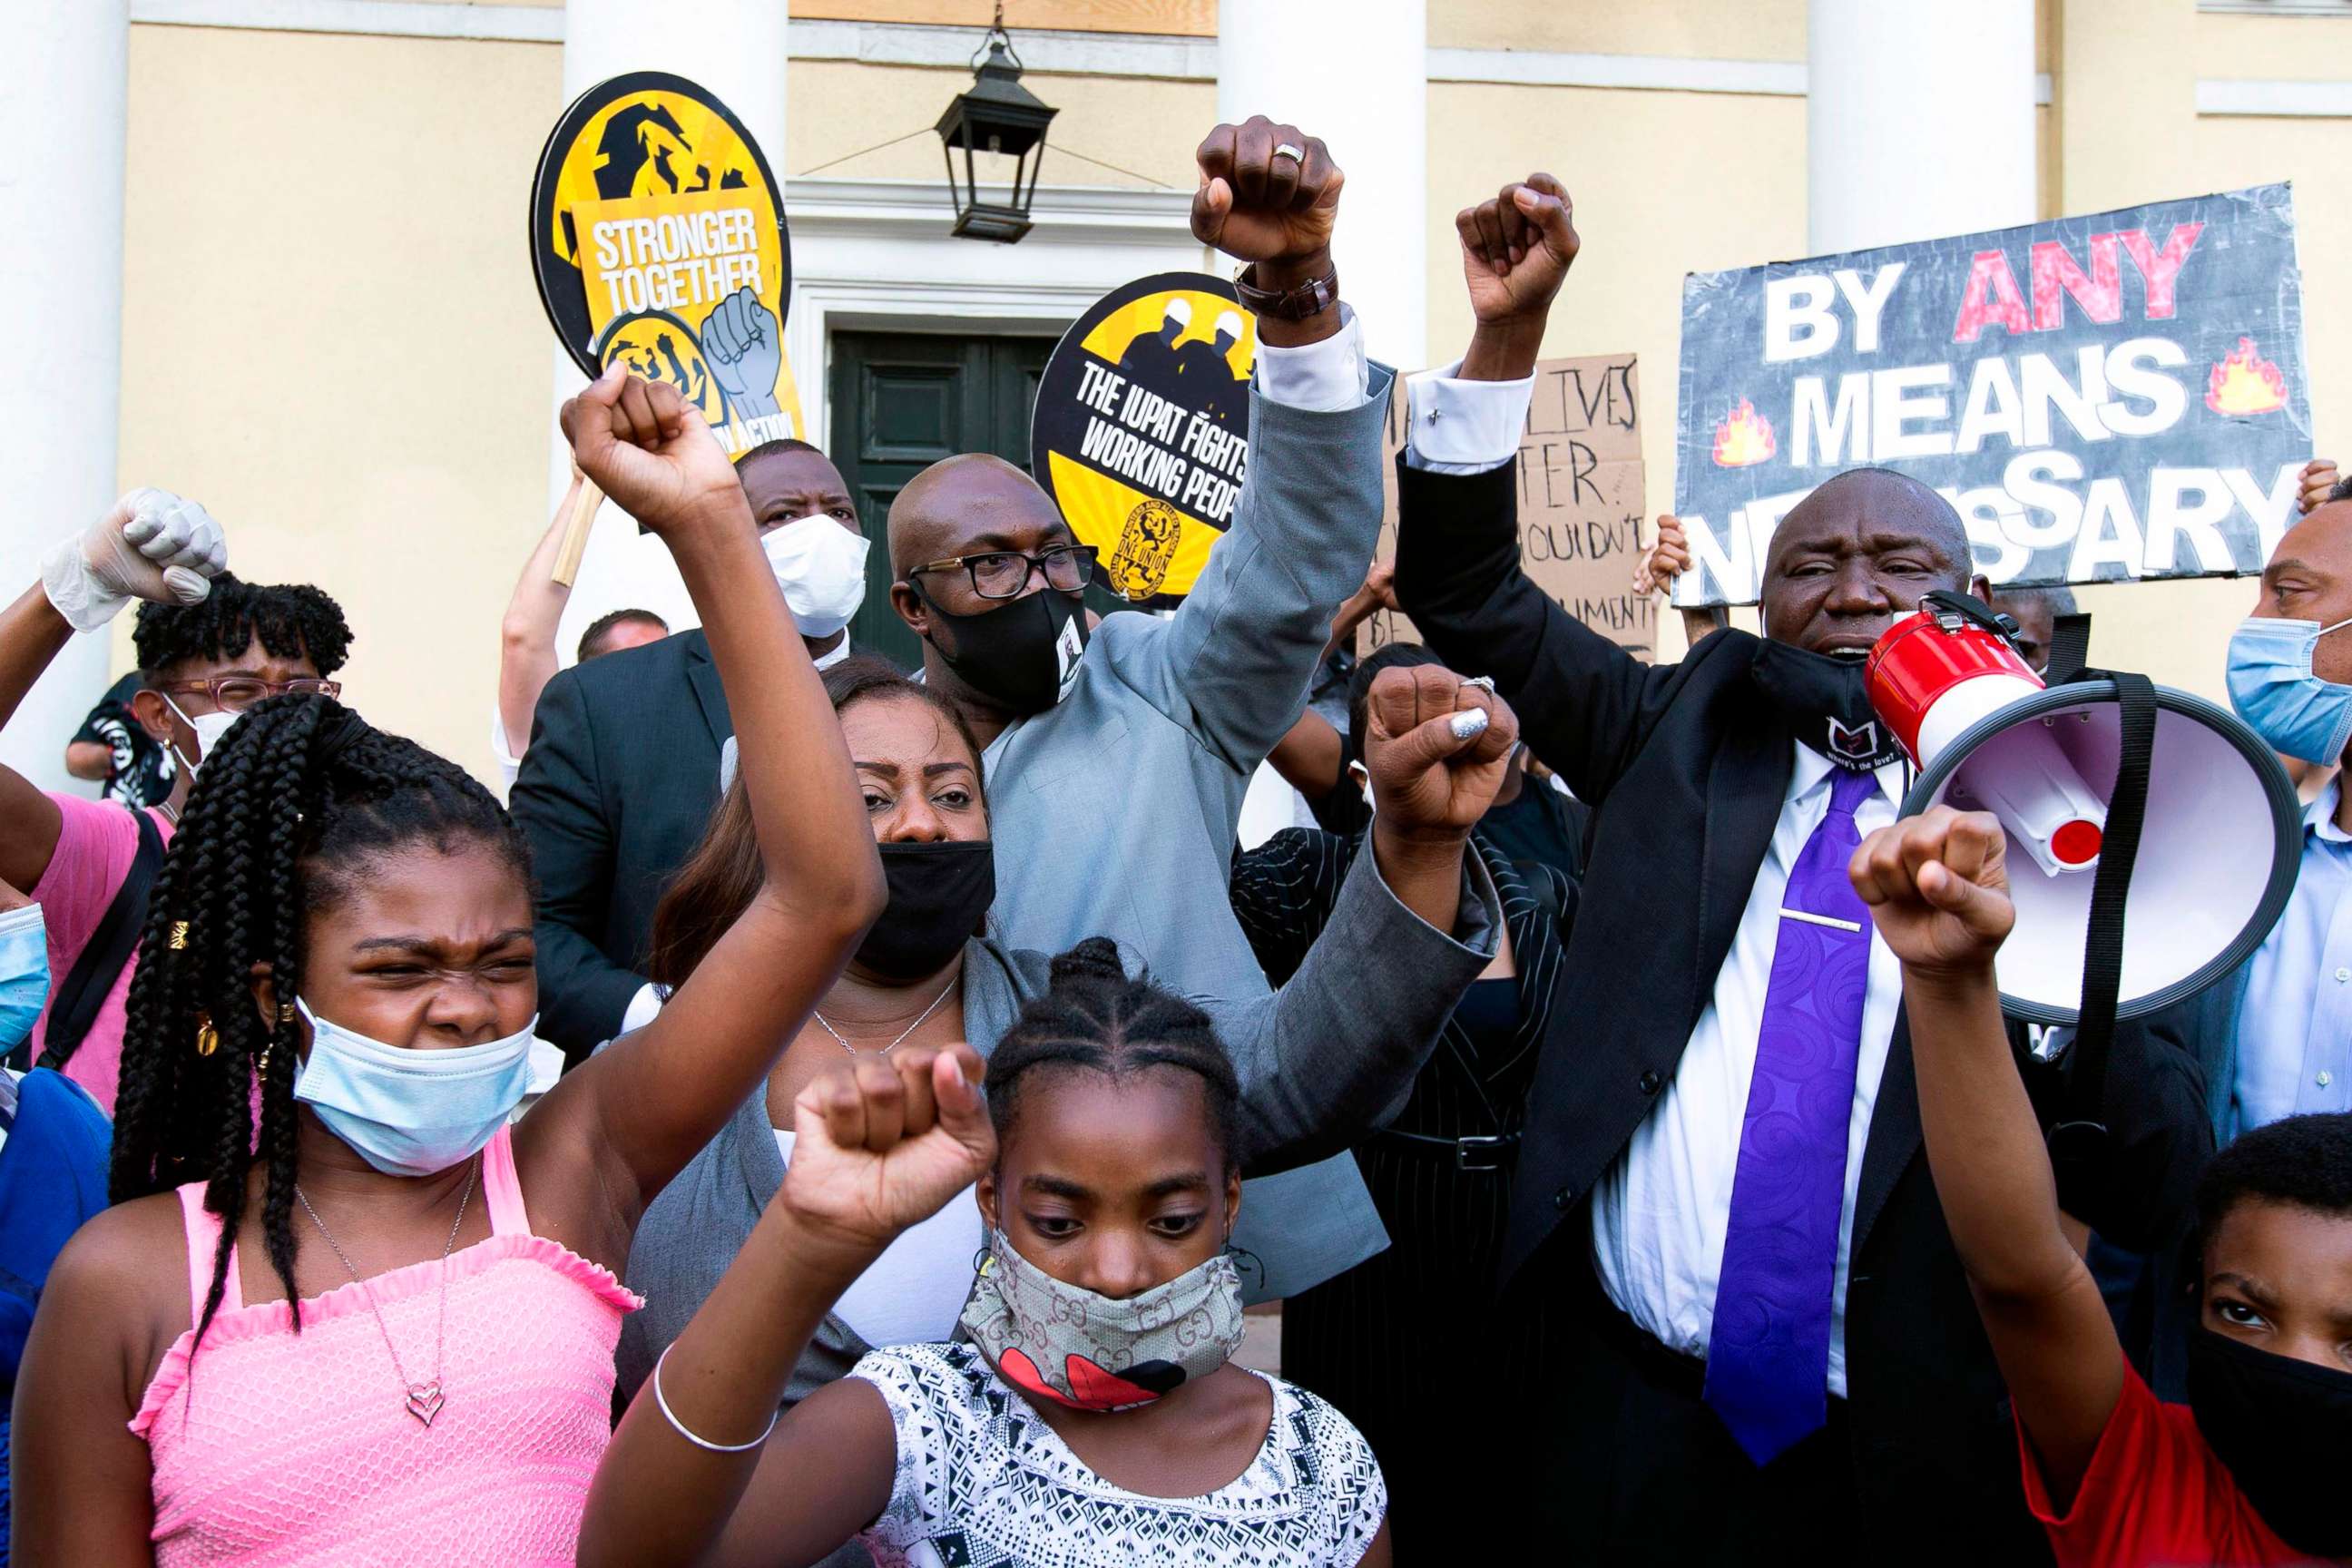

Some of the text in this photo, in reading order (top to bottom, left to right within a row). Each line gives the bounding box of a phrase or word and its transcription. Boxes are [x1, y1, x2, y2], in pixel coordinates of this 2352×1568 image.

[592, 208, 760, 270] STRONGER
[600, 253, 763, 317] TOGETHER
[1765, 222, 2205, 364] BY ANY
[1076, 360, 1249, 483] THE IUPAT FIGHTS
[1791, 338, 2189, 467] MEANS
[1080, 416, 1188, 498] WORKING
[1145, 501, 1161, 509] AND
[1671, 450, 2307, 607] NESSARY
[1118, 539, 1169, 573] ONE UNION
[1859, 762, 1872, 770] the
[1874, 752, 1895, 767] love?
